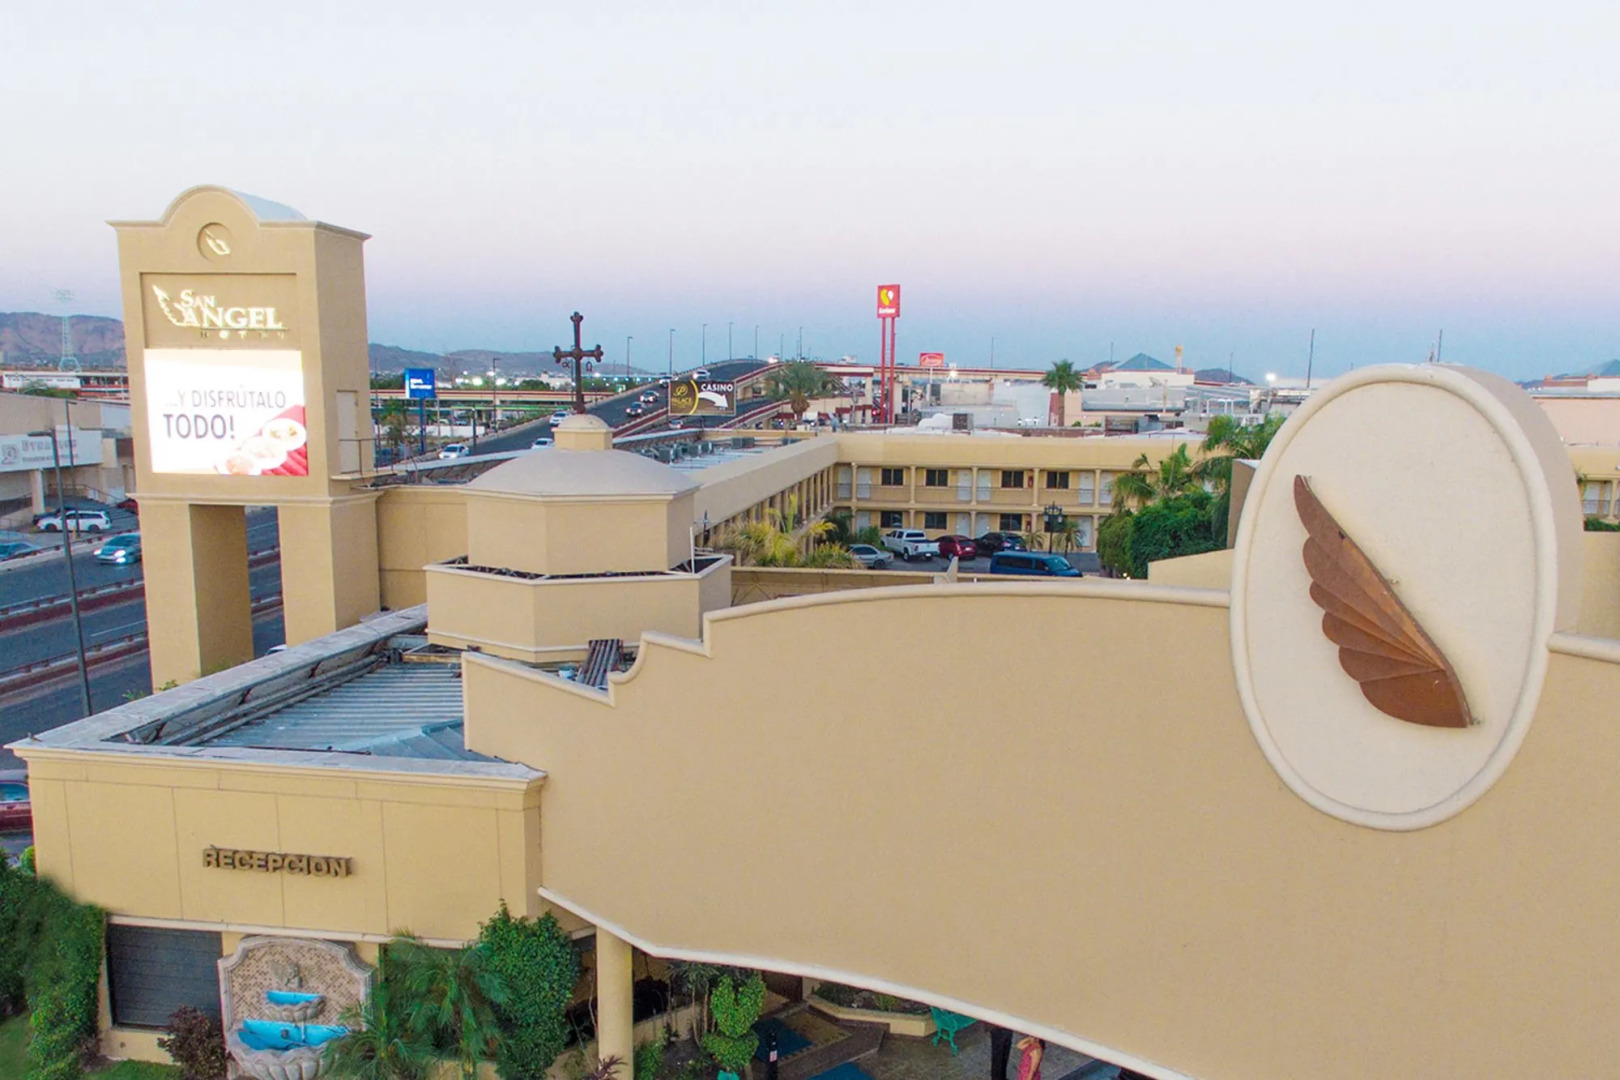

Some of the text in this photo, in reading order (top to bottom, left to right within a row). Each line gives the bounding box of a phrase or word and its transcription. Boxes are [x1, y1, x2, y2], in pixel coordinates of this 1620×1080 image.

[180, 289, 216, 308] SAN
[183, 306, 283, 328] ANGEL
[700, 383, 734, 392] CASINO
[163, 413, 236, 440] TODO!
[202, 847, 352, 878] RECEPCION
